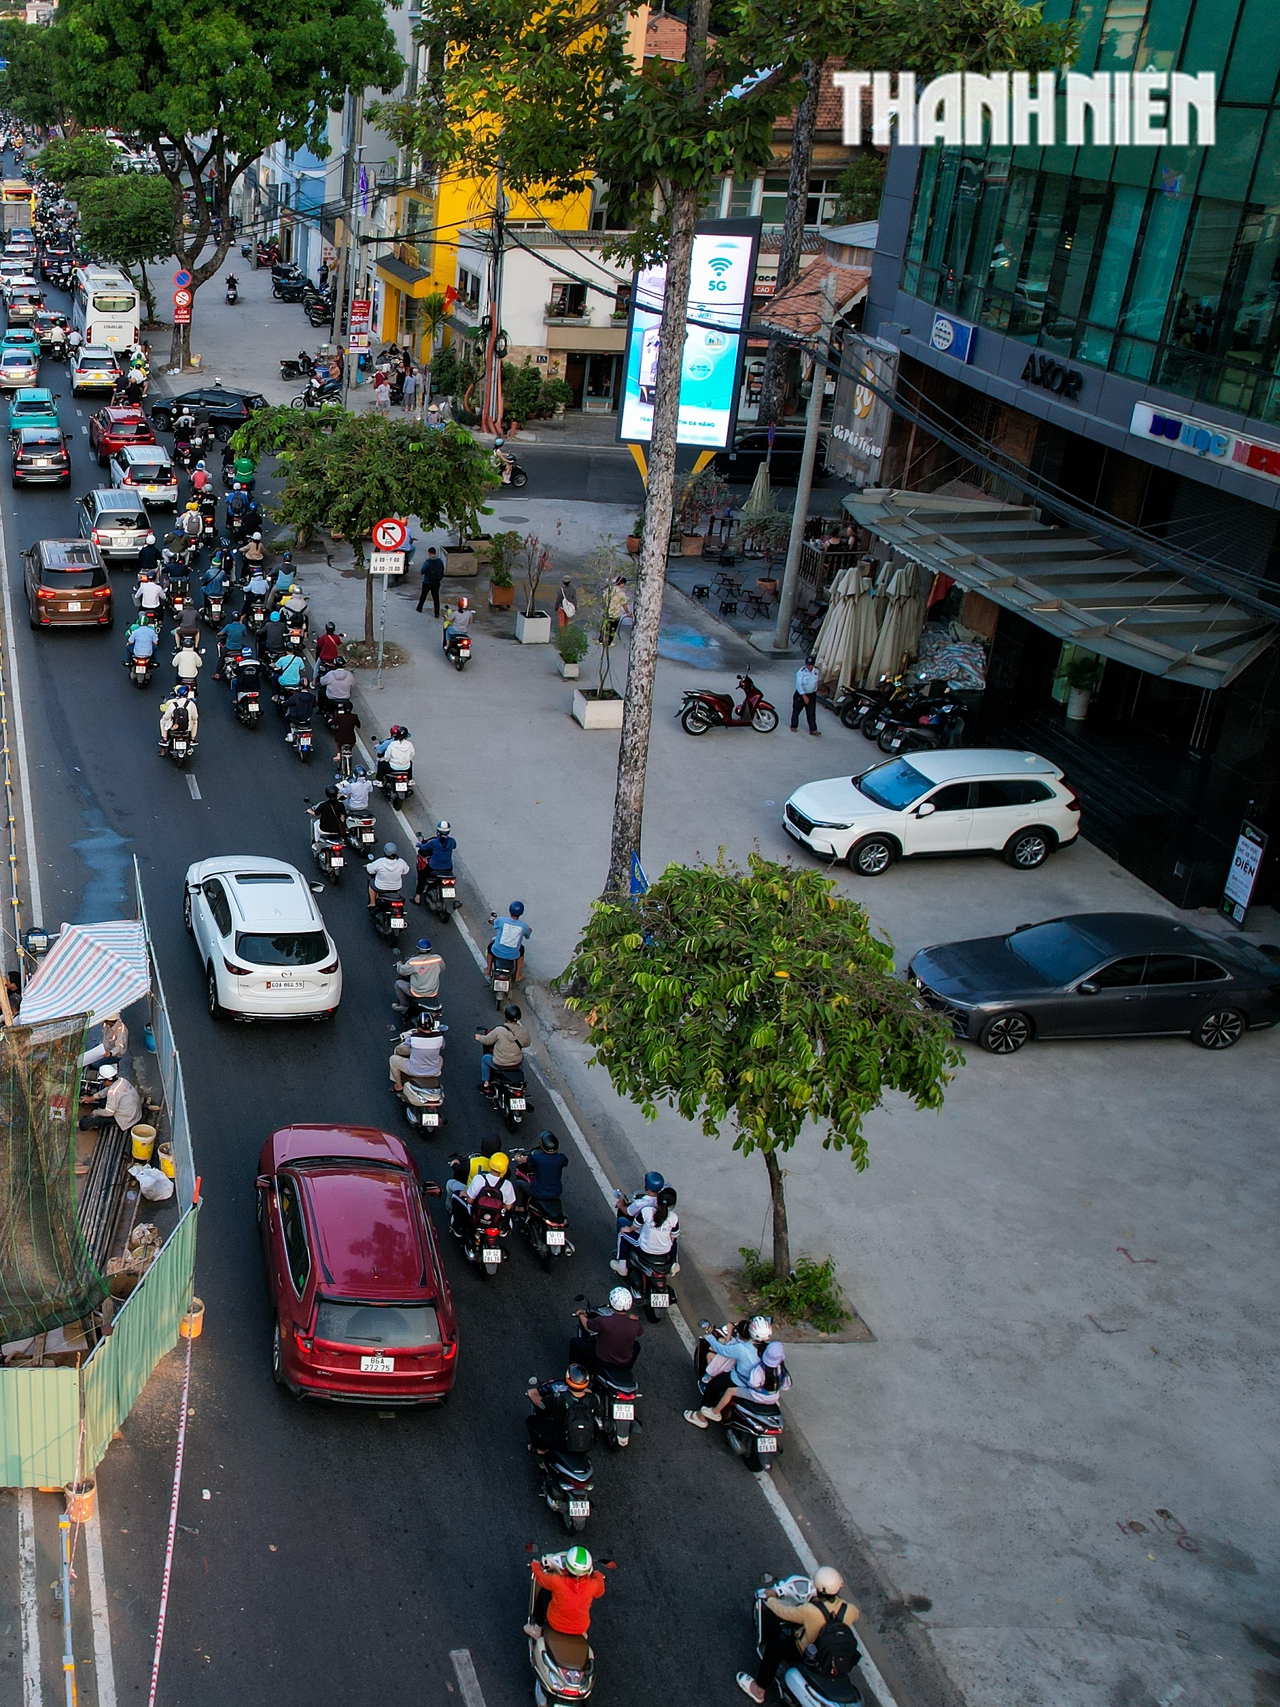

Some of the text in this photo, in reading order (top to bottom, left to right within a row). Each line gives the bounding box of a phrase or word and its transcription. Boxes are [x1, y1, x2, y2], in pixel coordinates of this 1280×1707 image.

[708, 280, 727, 292] 5G
[1021, 353, 1084, 402] AXOR
[1180, 422, 1229, 457] HỌC
[1234, 855, 1255, 877] ĐIỆN
[364, 1364, 390, 1372] 272.75
